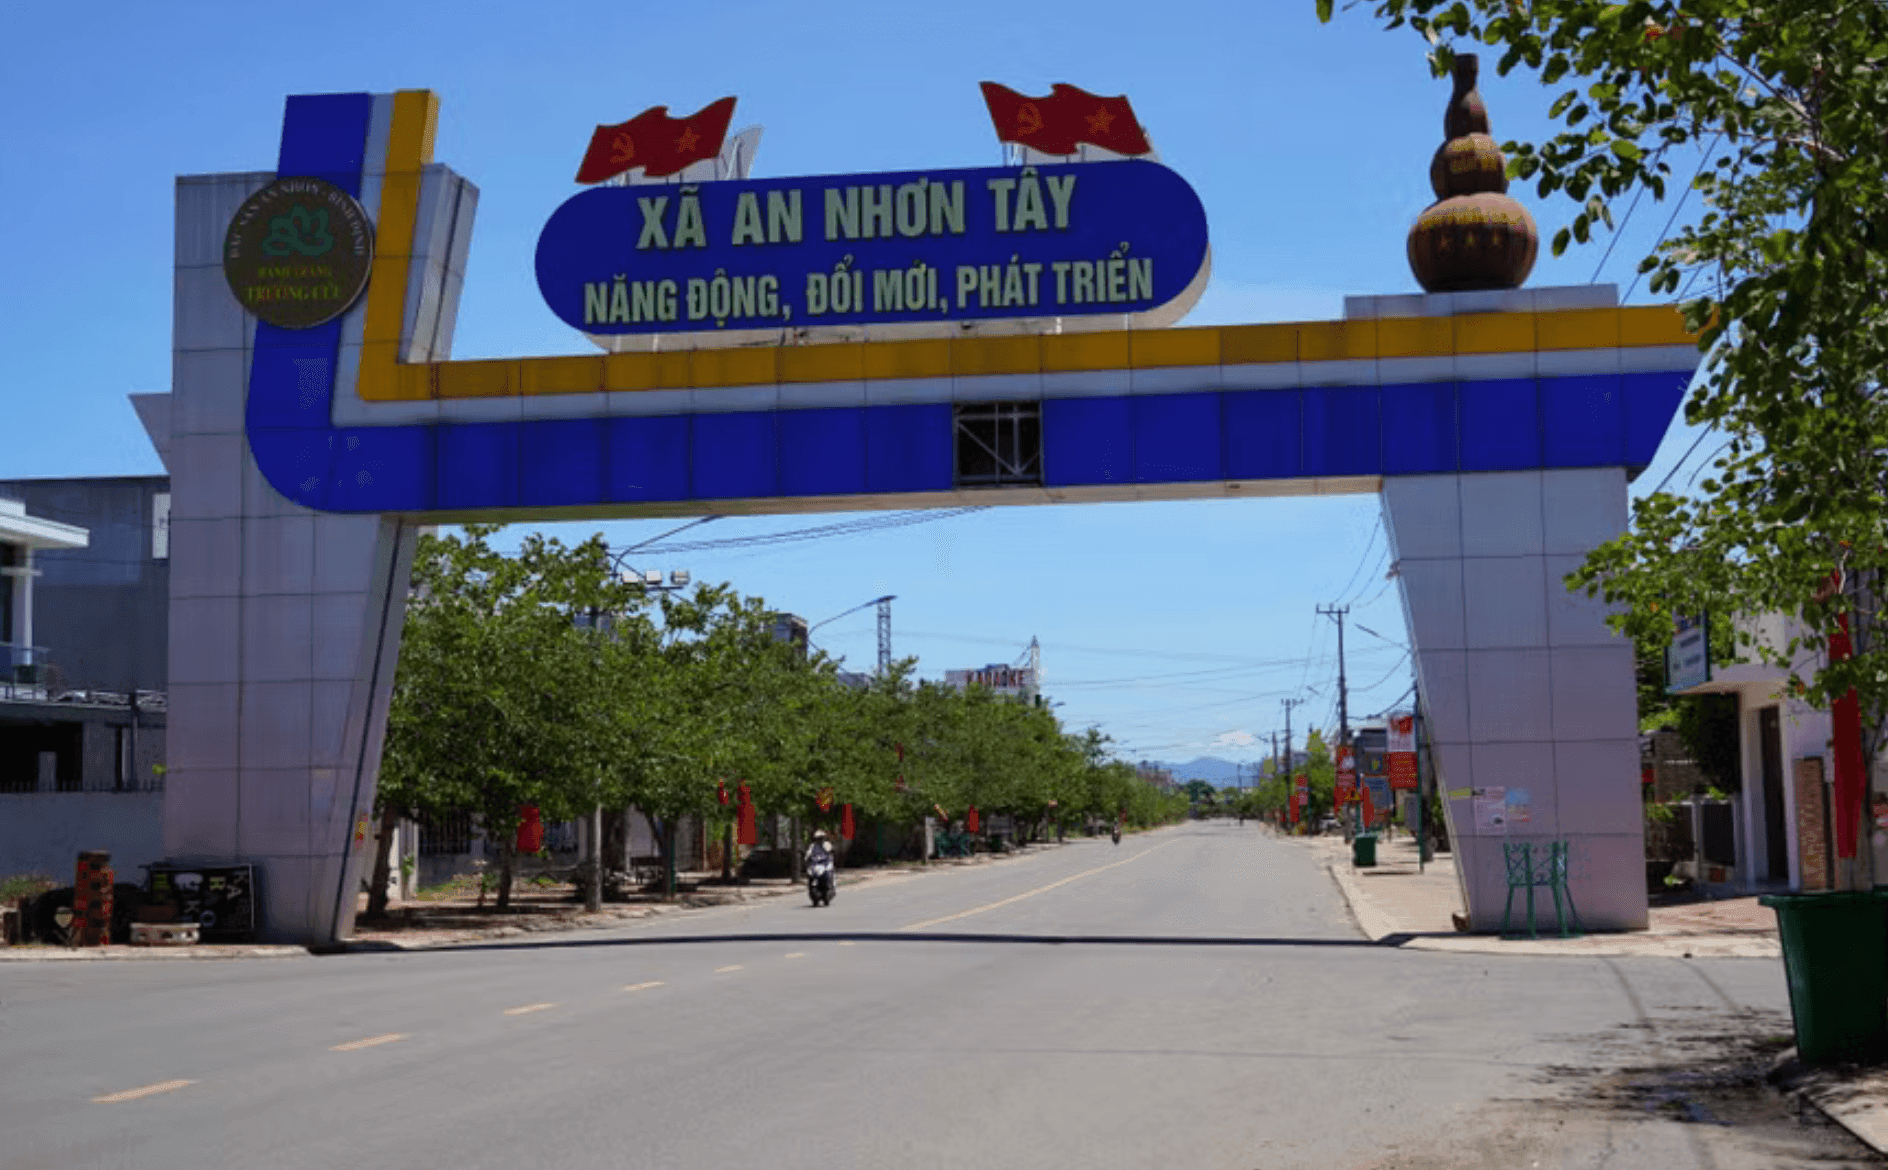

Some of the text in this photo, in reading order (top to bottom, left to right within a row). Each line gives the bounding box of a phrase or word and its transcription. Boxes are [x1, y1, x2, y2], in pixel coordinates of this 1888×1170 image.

[636, 166, 1077, 249] XÃ AN NHƠN TÂY
[584, 272, 678, 325] NĂNG
[686, 267, 792, 328] ĐỘNG,
[805, 253, 863, 315] ĐỔI
[955, 252, 1043, 309] PHÁT
[1051, 241, 1154, 304] TRIỂN
